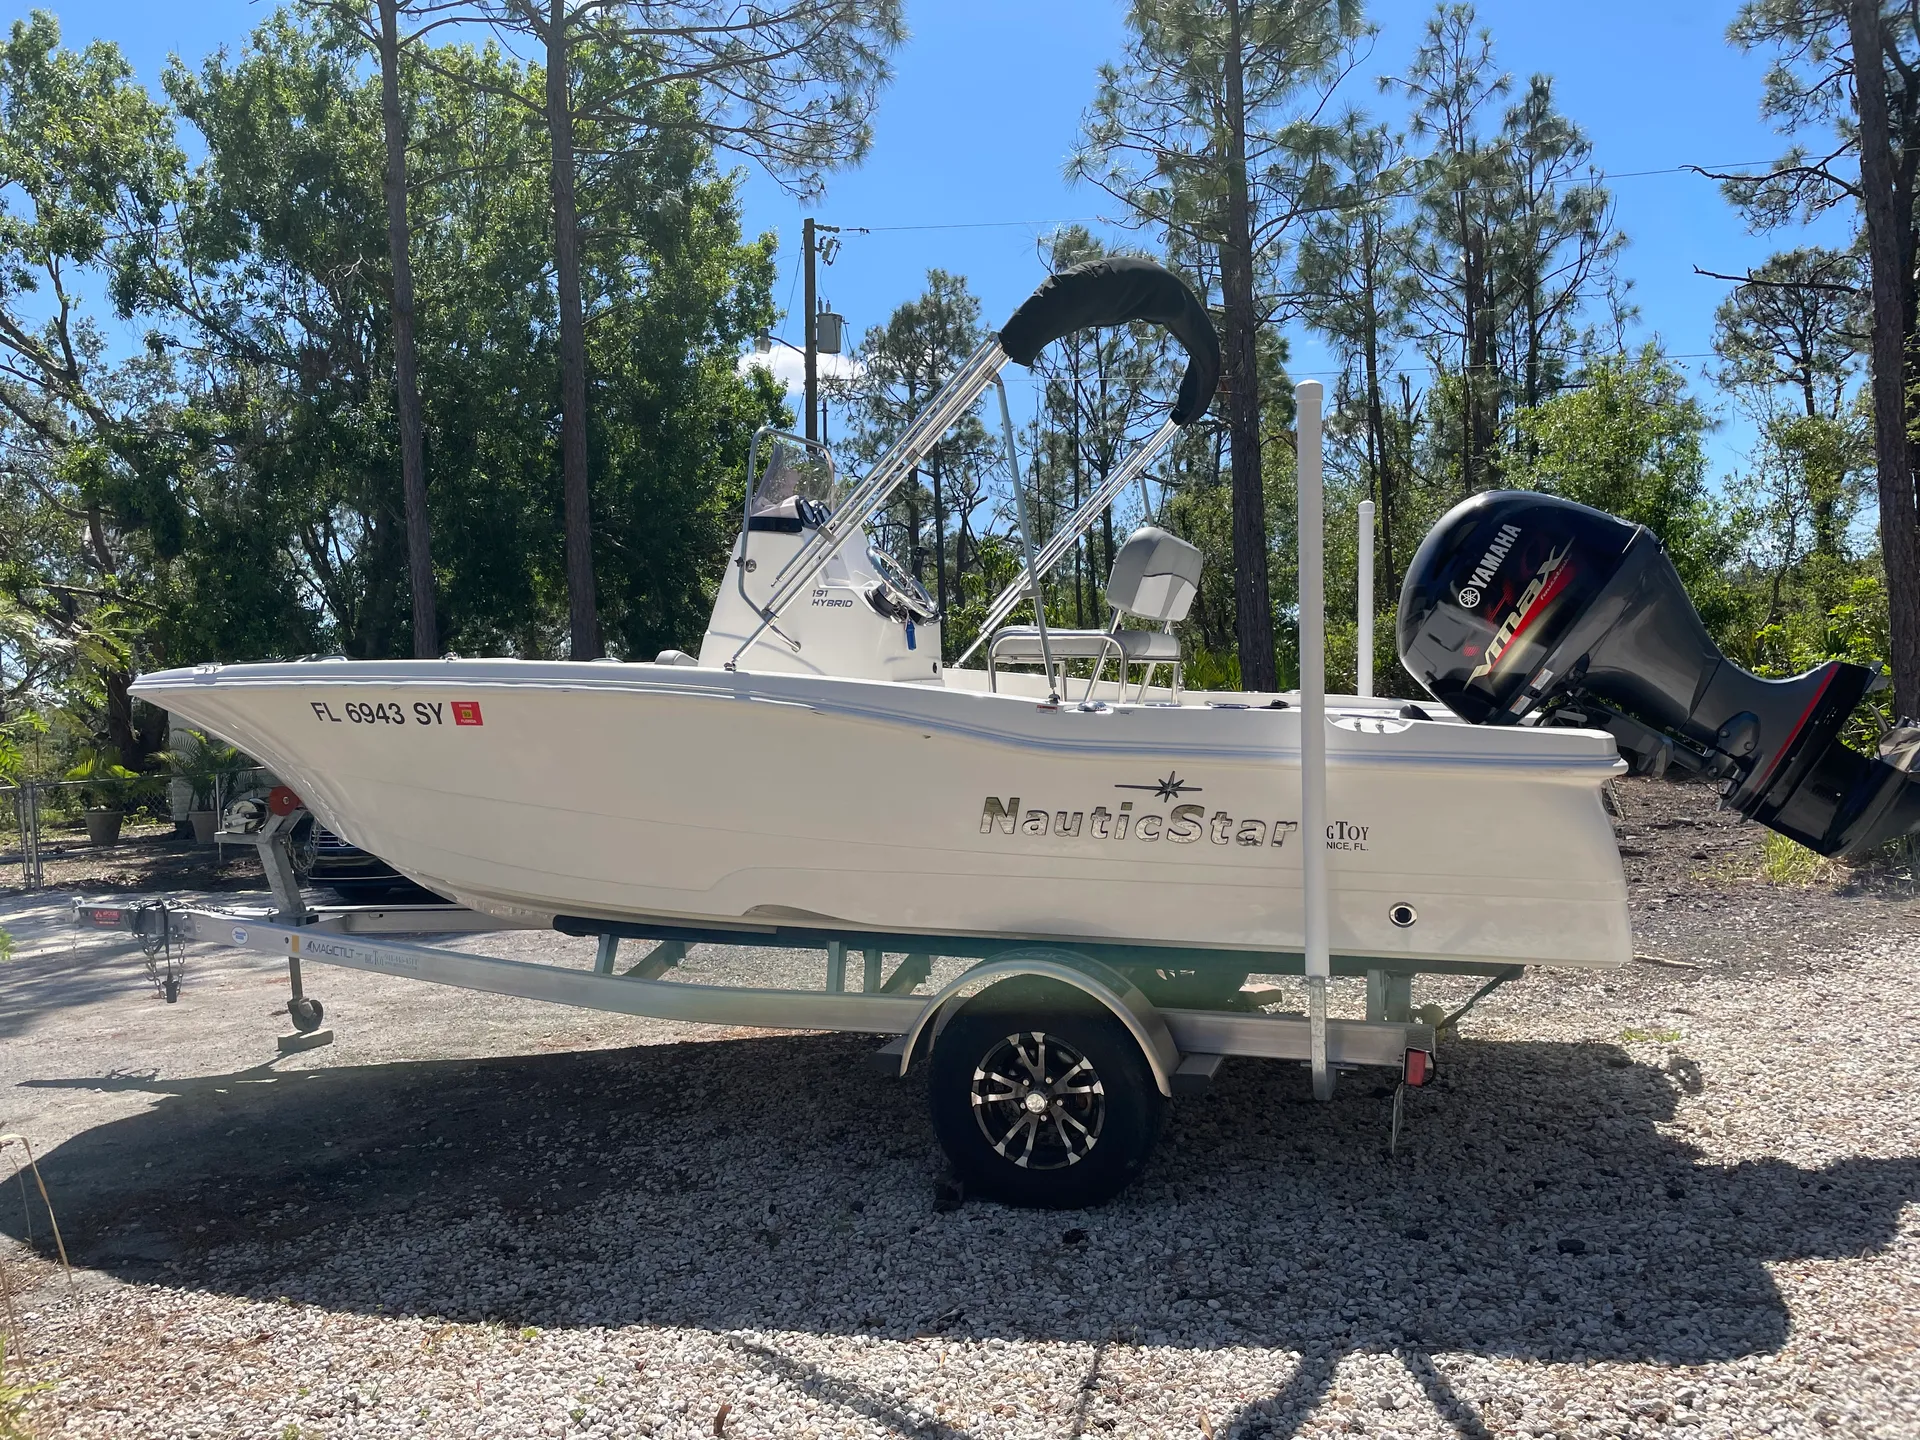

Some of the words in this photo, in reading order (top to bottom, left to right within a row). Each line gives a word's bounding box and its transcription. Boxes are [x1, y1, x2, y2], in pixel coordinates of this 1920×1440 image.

[1467, 523, 1522, 589] YAMAHA
[812, 589, 828, 598] 191
[811, 599, 853, 608] HYBRID
[310, 702, 342, 722] FL
[345, 702, 405, 724] 6943
[413, 702, 443, 725] SY
[979, 796, 1298, 848] NauticStar
[1326, 841, 1352, 851] NICE,
[1354, 842, 1369, 851] FL.
